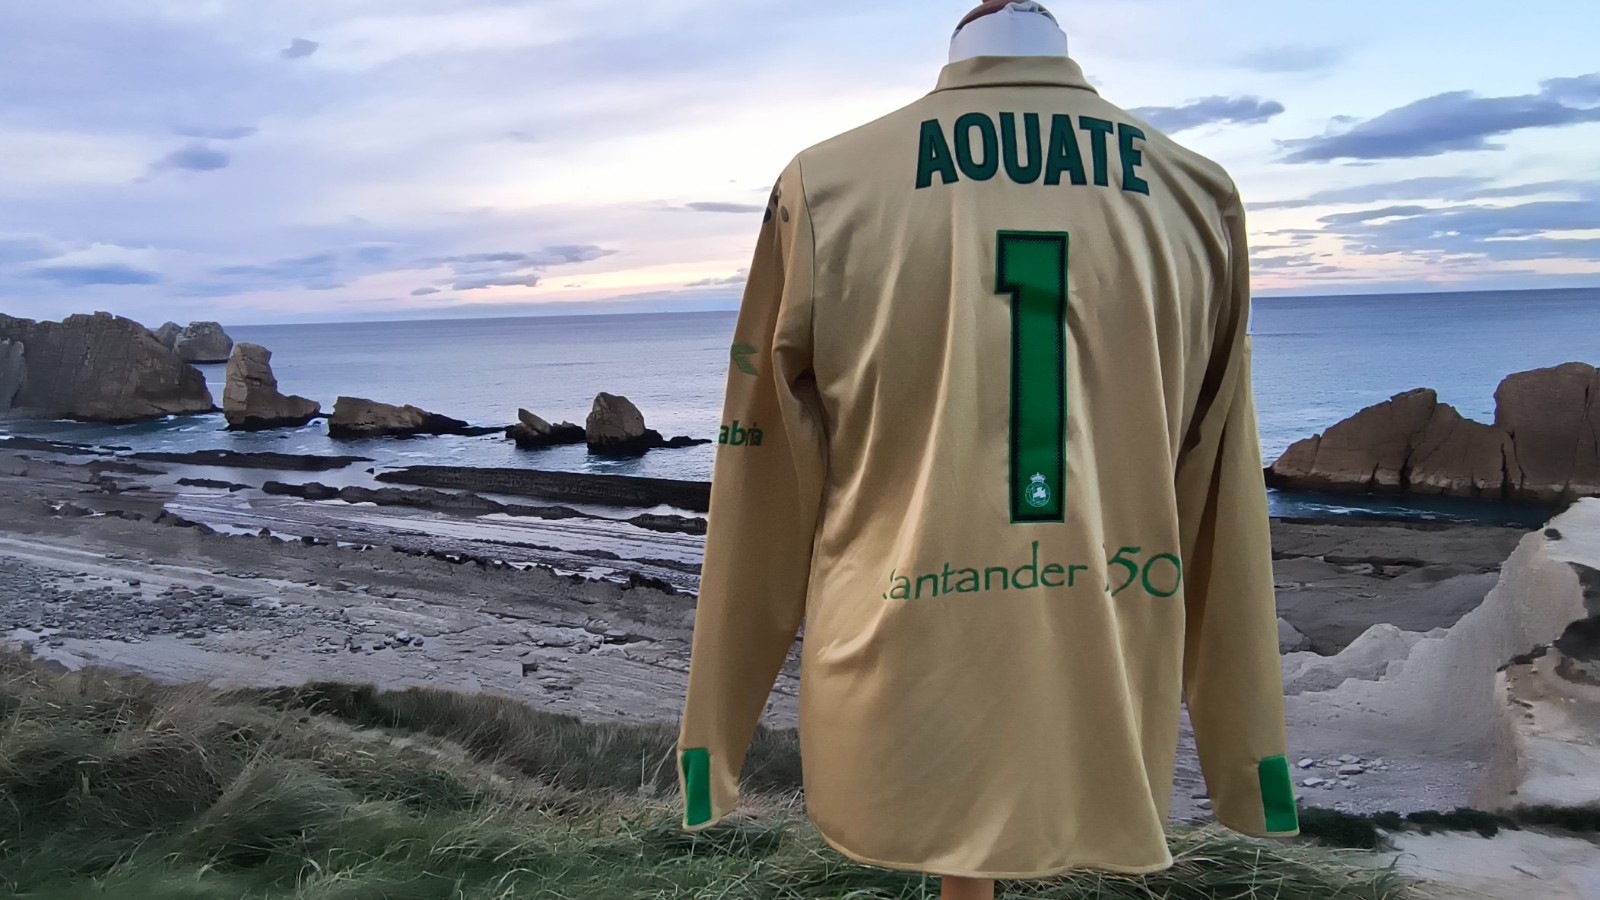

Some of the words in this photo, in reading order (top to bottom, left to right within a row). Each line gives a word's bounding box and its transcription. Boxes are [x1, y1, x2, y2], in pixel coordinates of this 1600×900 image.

[915, 112, 1149, 196] AOUATE
[995, 230, 1069, 523] 1
[883, 541, 1088, 600] antander
[1103, 544, 1181, 598] 50
